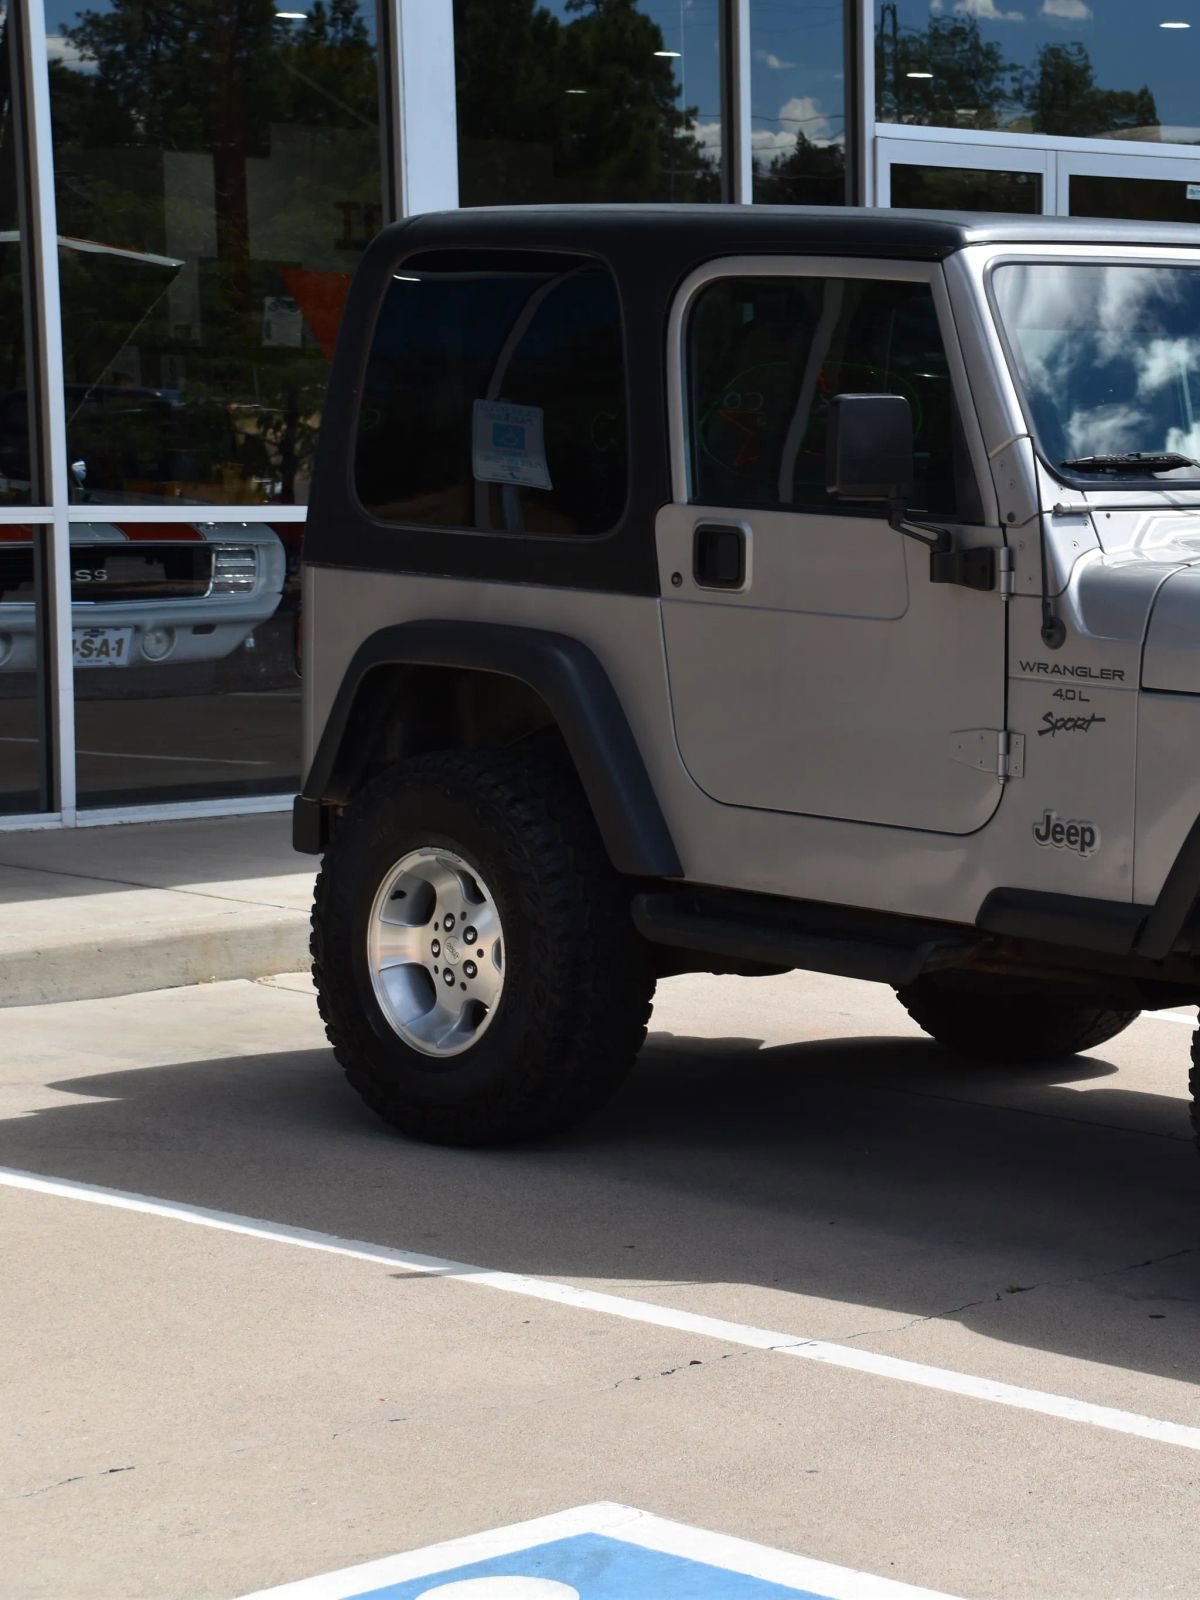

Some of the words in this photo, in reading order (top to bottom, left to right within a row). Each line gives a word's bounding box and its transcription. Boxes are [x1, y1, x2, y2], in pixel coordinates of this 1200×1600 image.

[74, 568, 108, 582] SS
[1019, 660, 1126, 682] WRANGLER
[1034, 812, 1096, 853] Jeep
